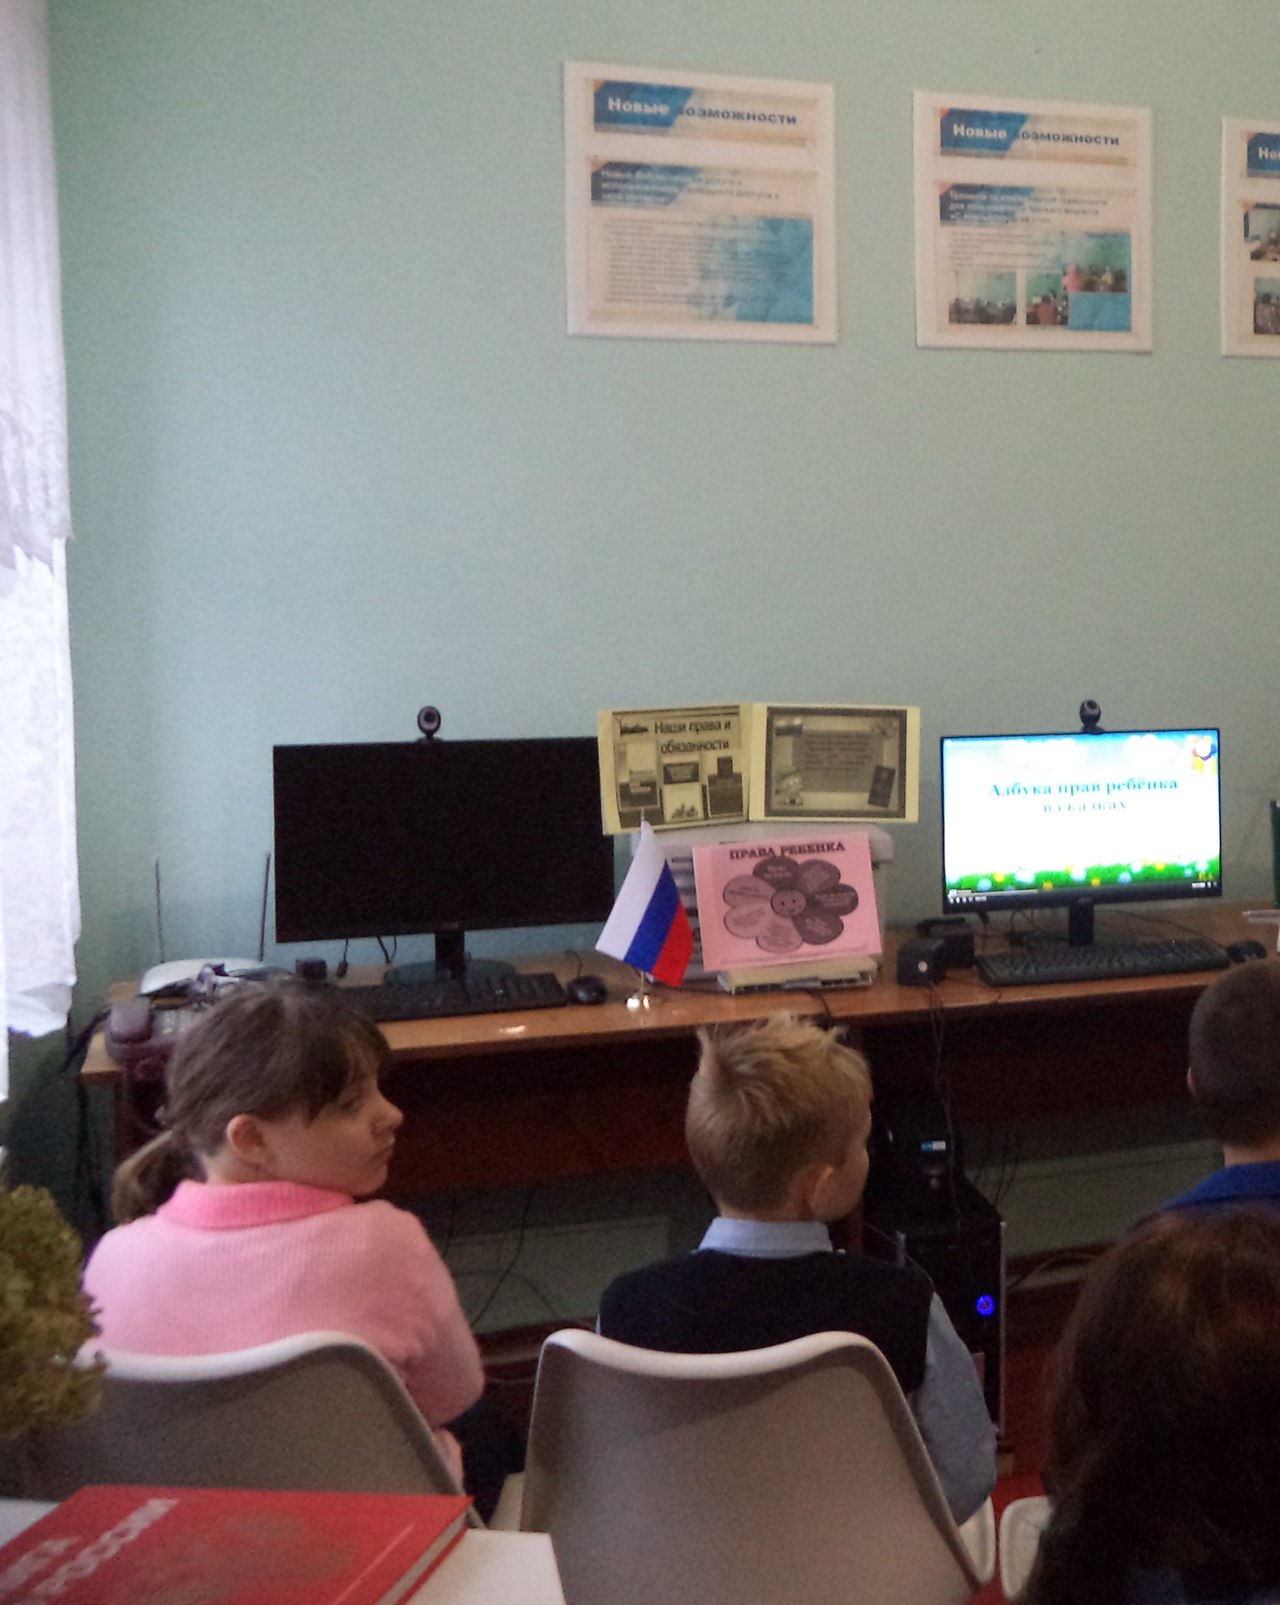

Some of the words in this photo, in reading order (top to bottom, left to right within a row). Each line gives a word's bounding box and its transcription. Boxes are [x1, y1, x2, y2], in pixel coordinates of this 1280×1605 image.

[608, 96, 670, 115] Новые
[679, 107, 797, 125] озможности
[953, 123, 1008, 139] Новые
[1016, 130, 1119, 146] озможности
[654, 721, 686, 735] Наши
[724, 719, 732, 731] и
[989, 782, 1052, 800] Азбука
[1058, 783, 1101, 797] прав
[729, 846, 777, 860] ПРАВА
